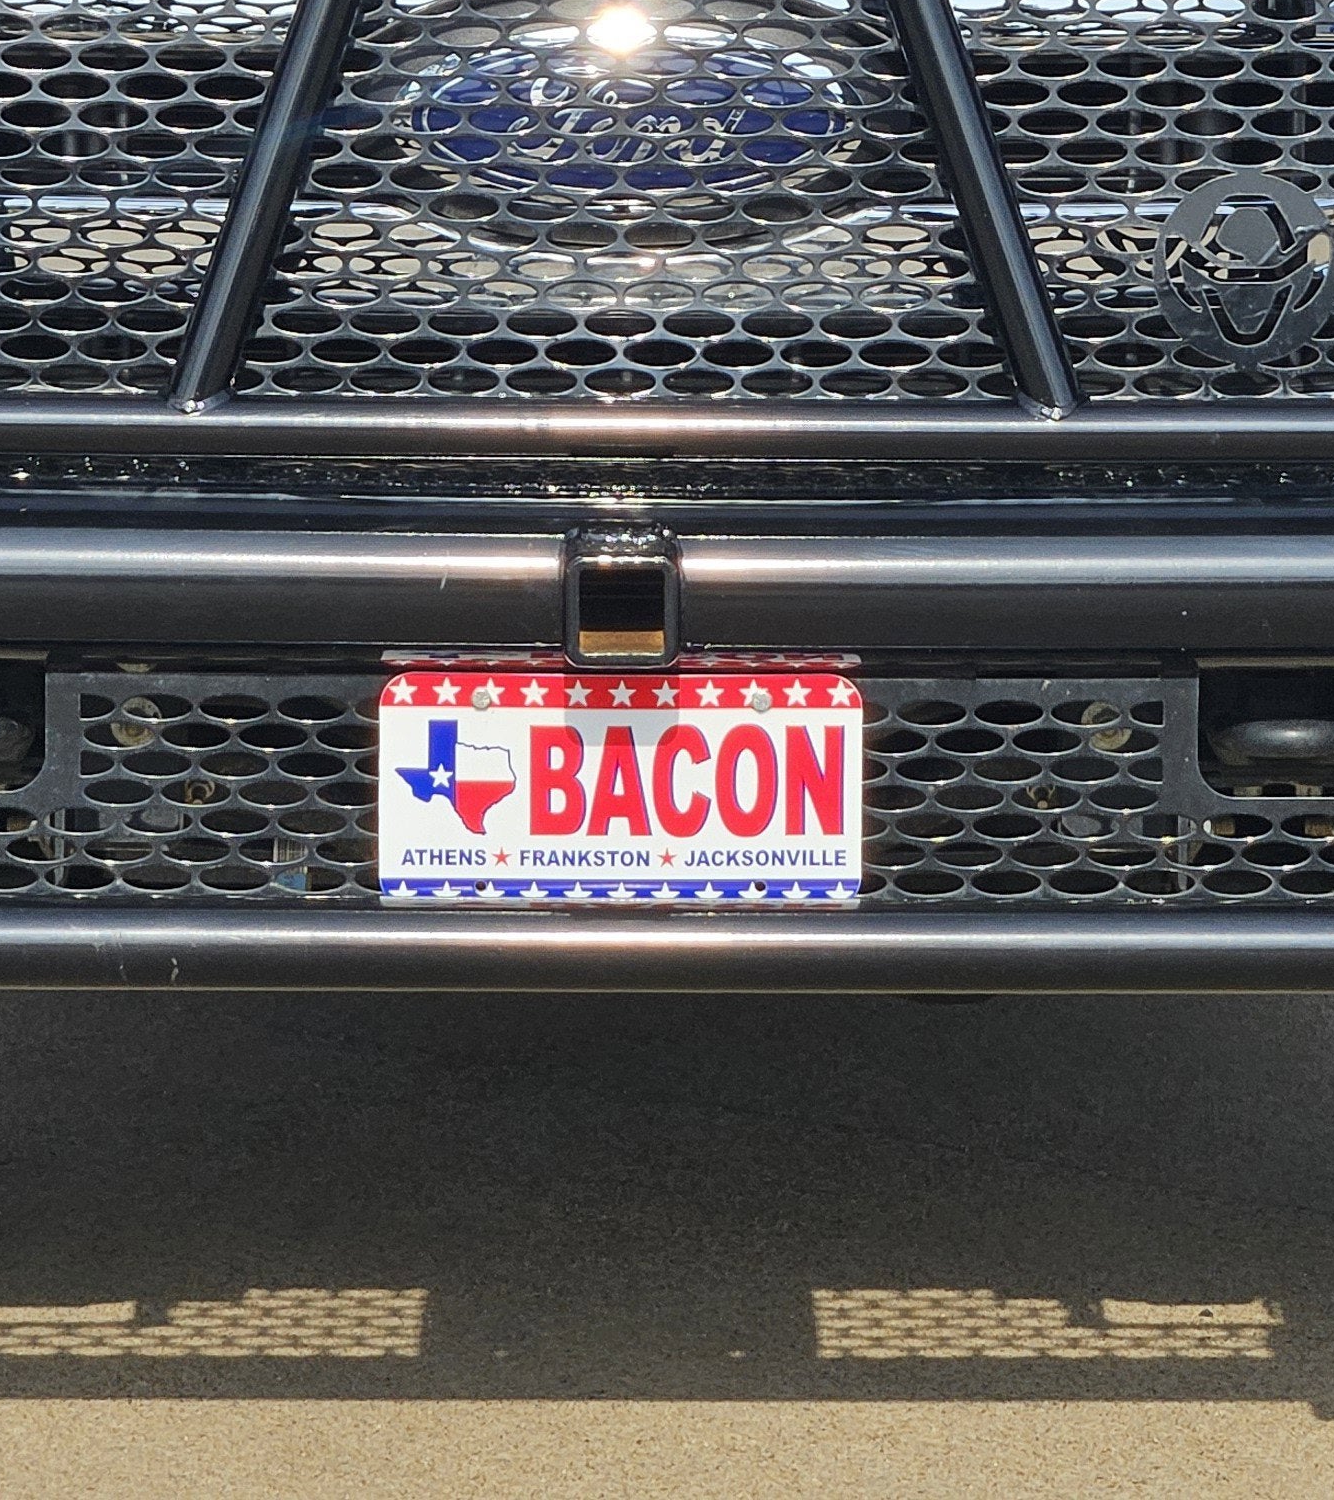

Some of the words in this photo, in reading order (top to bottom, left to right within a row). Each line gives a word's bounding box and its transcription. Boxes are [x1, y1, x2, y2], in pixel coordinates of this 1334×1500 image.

[529, 723, 845, 838] BACON
[401, 848, 487, 867] ATHENS
[519, 849, 651, 868] FRANKSTON
[684, 849, 847, 868] JACKSONVILLE
